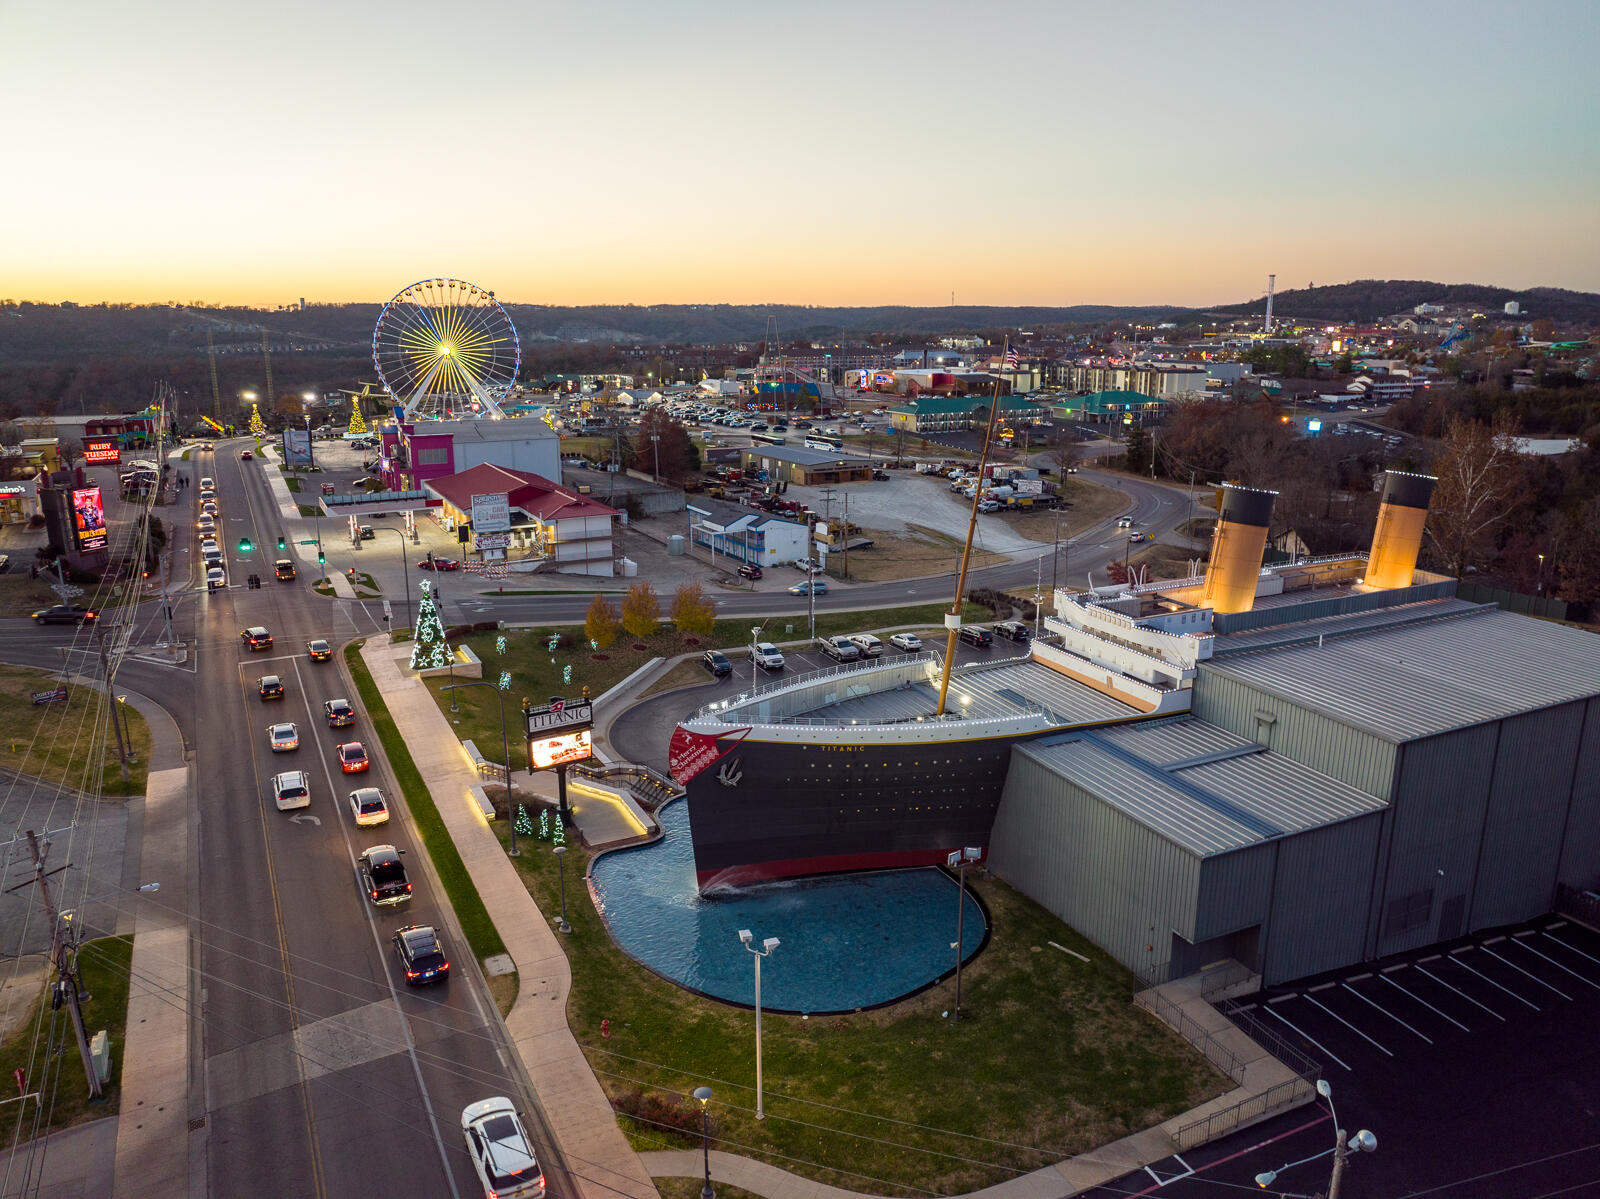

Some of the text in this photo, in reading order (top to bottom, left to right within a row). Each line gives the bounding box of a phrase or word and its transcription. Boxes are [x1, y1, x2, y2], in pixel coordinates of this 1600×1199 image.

[84, 450, 119, 458] TUESDAY
[530, 708, 590, 727] TITANIC
[676, 745, 708, 769] Christmas
[677, 744, 696, 761] Merry
